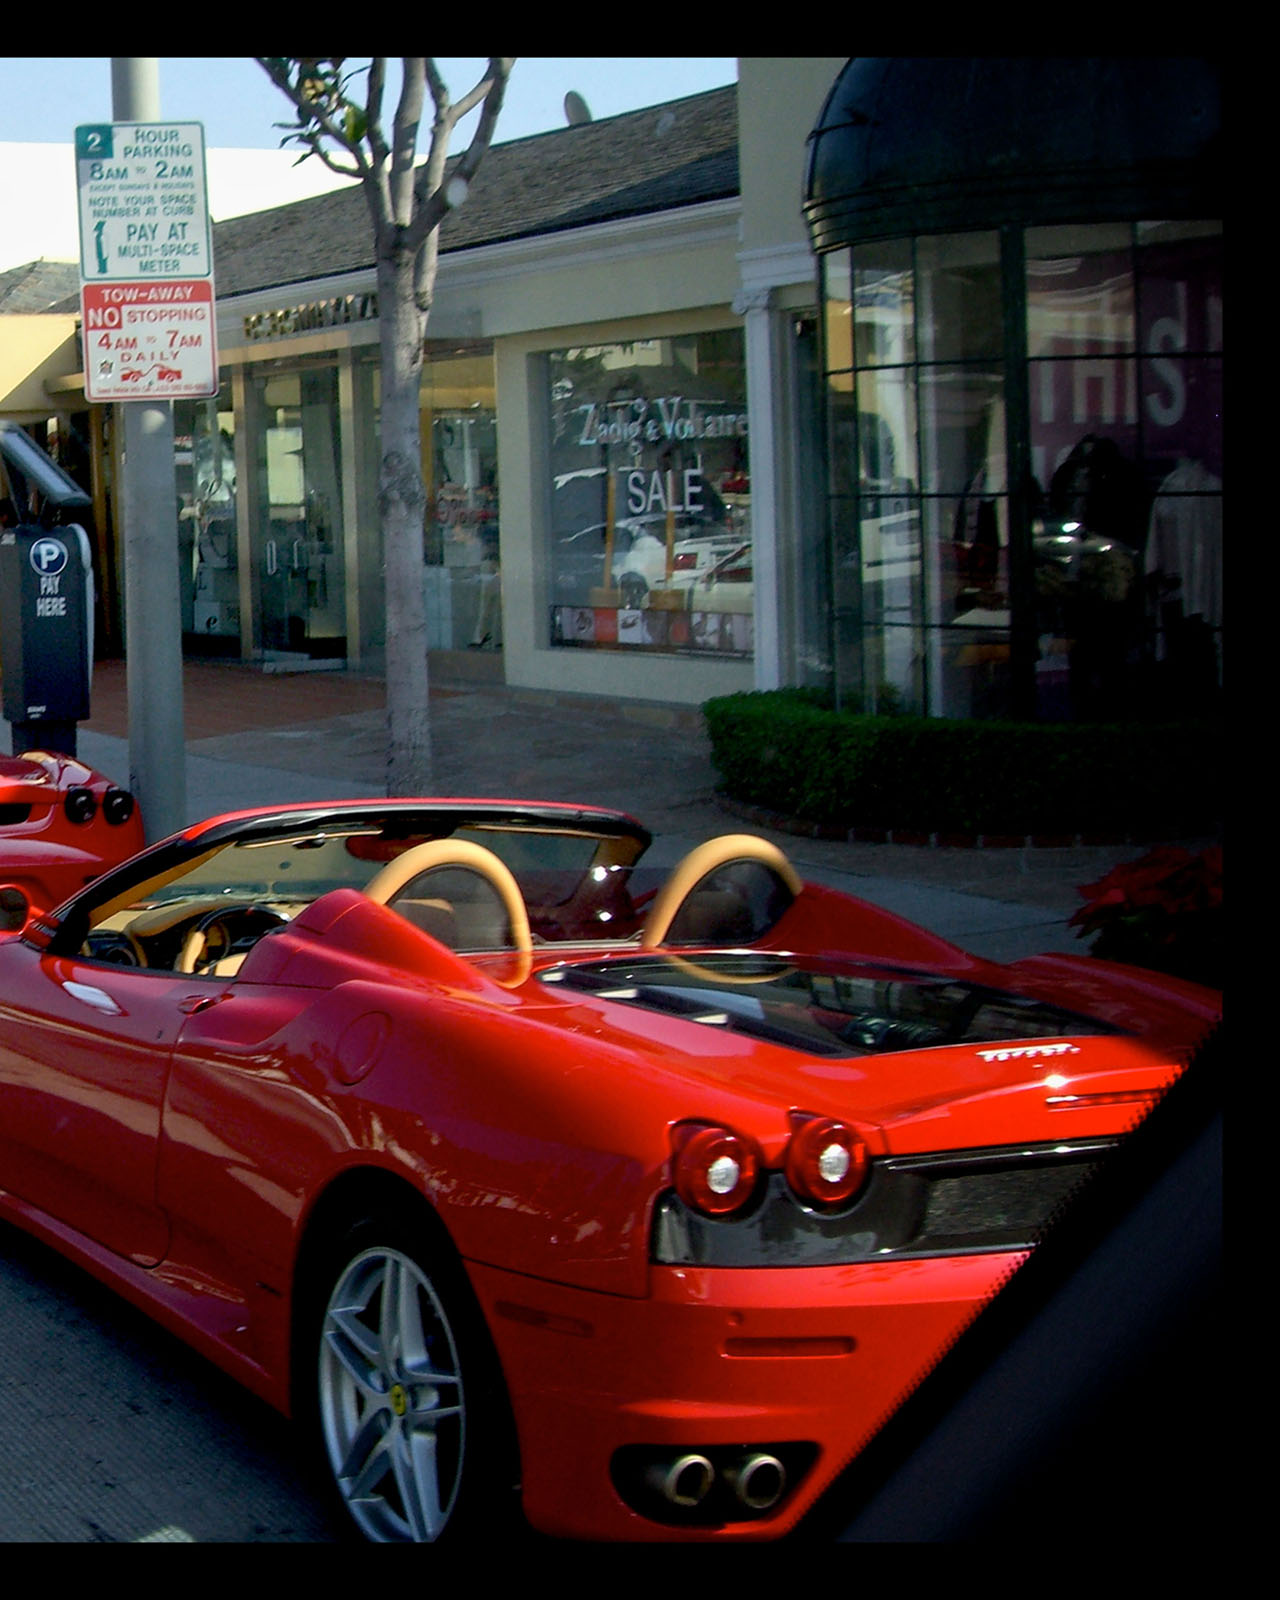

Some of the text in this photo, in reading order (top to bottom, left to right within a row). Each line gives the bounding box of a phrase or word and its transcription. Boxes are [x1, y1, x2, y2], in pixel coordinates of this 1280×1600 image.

[87, 133, 101, 150] 2
[134, 128, 179, 143] HOUR
[123, 145, 193, 158] PARKING
[89, 193, 196, 207] NOTE YOUR SPACE
[93, 205, 194, 218] NUMBER AT CURB
[126, 222, 188, 241] PAY AT
[118, 242, 200, 258] MULTI-SPACE
[139, 258, 180, 273] METER
[101, 286, 193, 302] TOW-AWAY
[88, 307, 206, 327] NO STOPPING
[120, 351, 180, 363] DAILY
[628, 468, 704, 514] SALE
[40, 575, 60, 595] PAY
[37, 596, 67, 617] HERE
